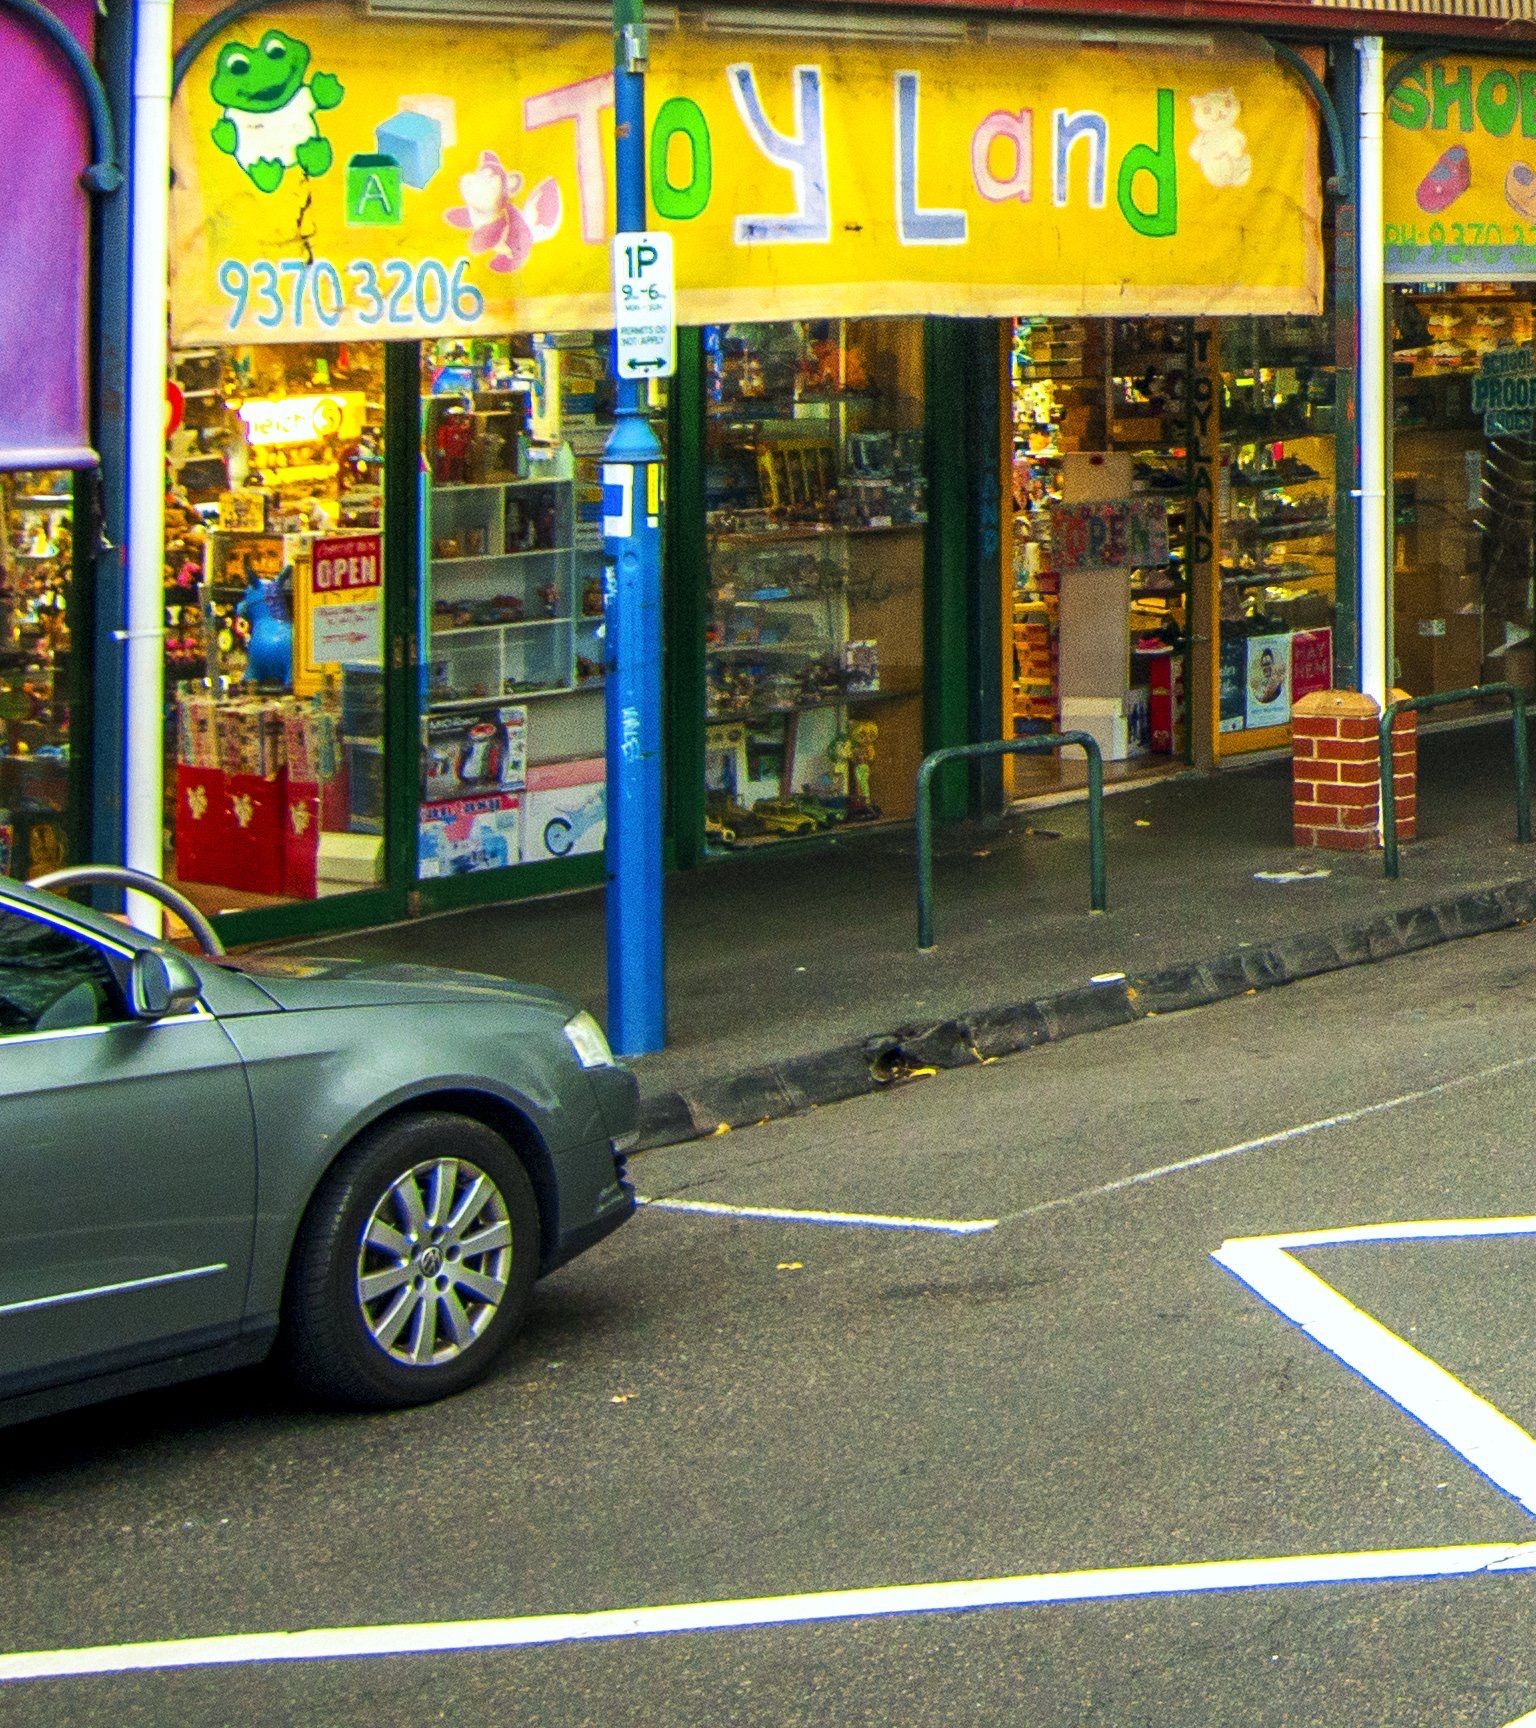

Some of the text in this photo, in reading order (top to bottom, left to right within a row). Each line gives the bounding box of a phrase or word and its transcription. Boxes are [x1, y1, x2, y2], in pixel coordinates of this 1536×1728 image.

[892, 69, 1178, 245] Land
[354, 174, 391, 215] A
[625, 245, 658, 278] 1P
[317, 555, 377, 589] OPEN
